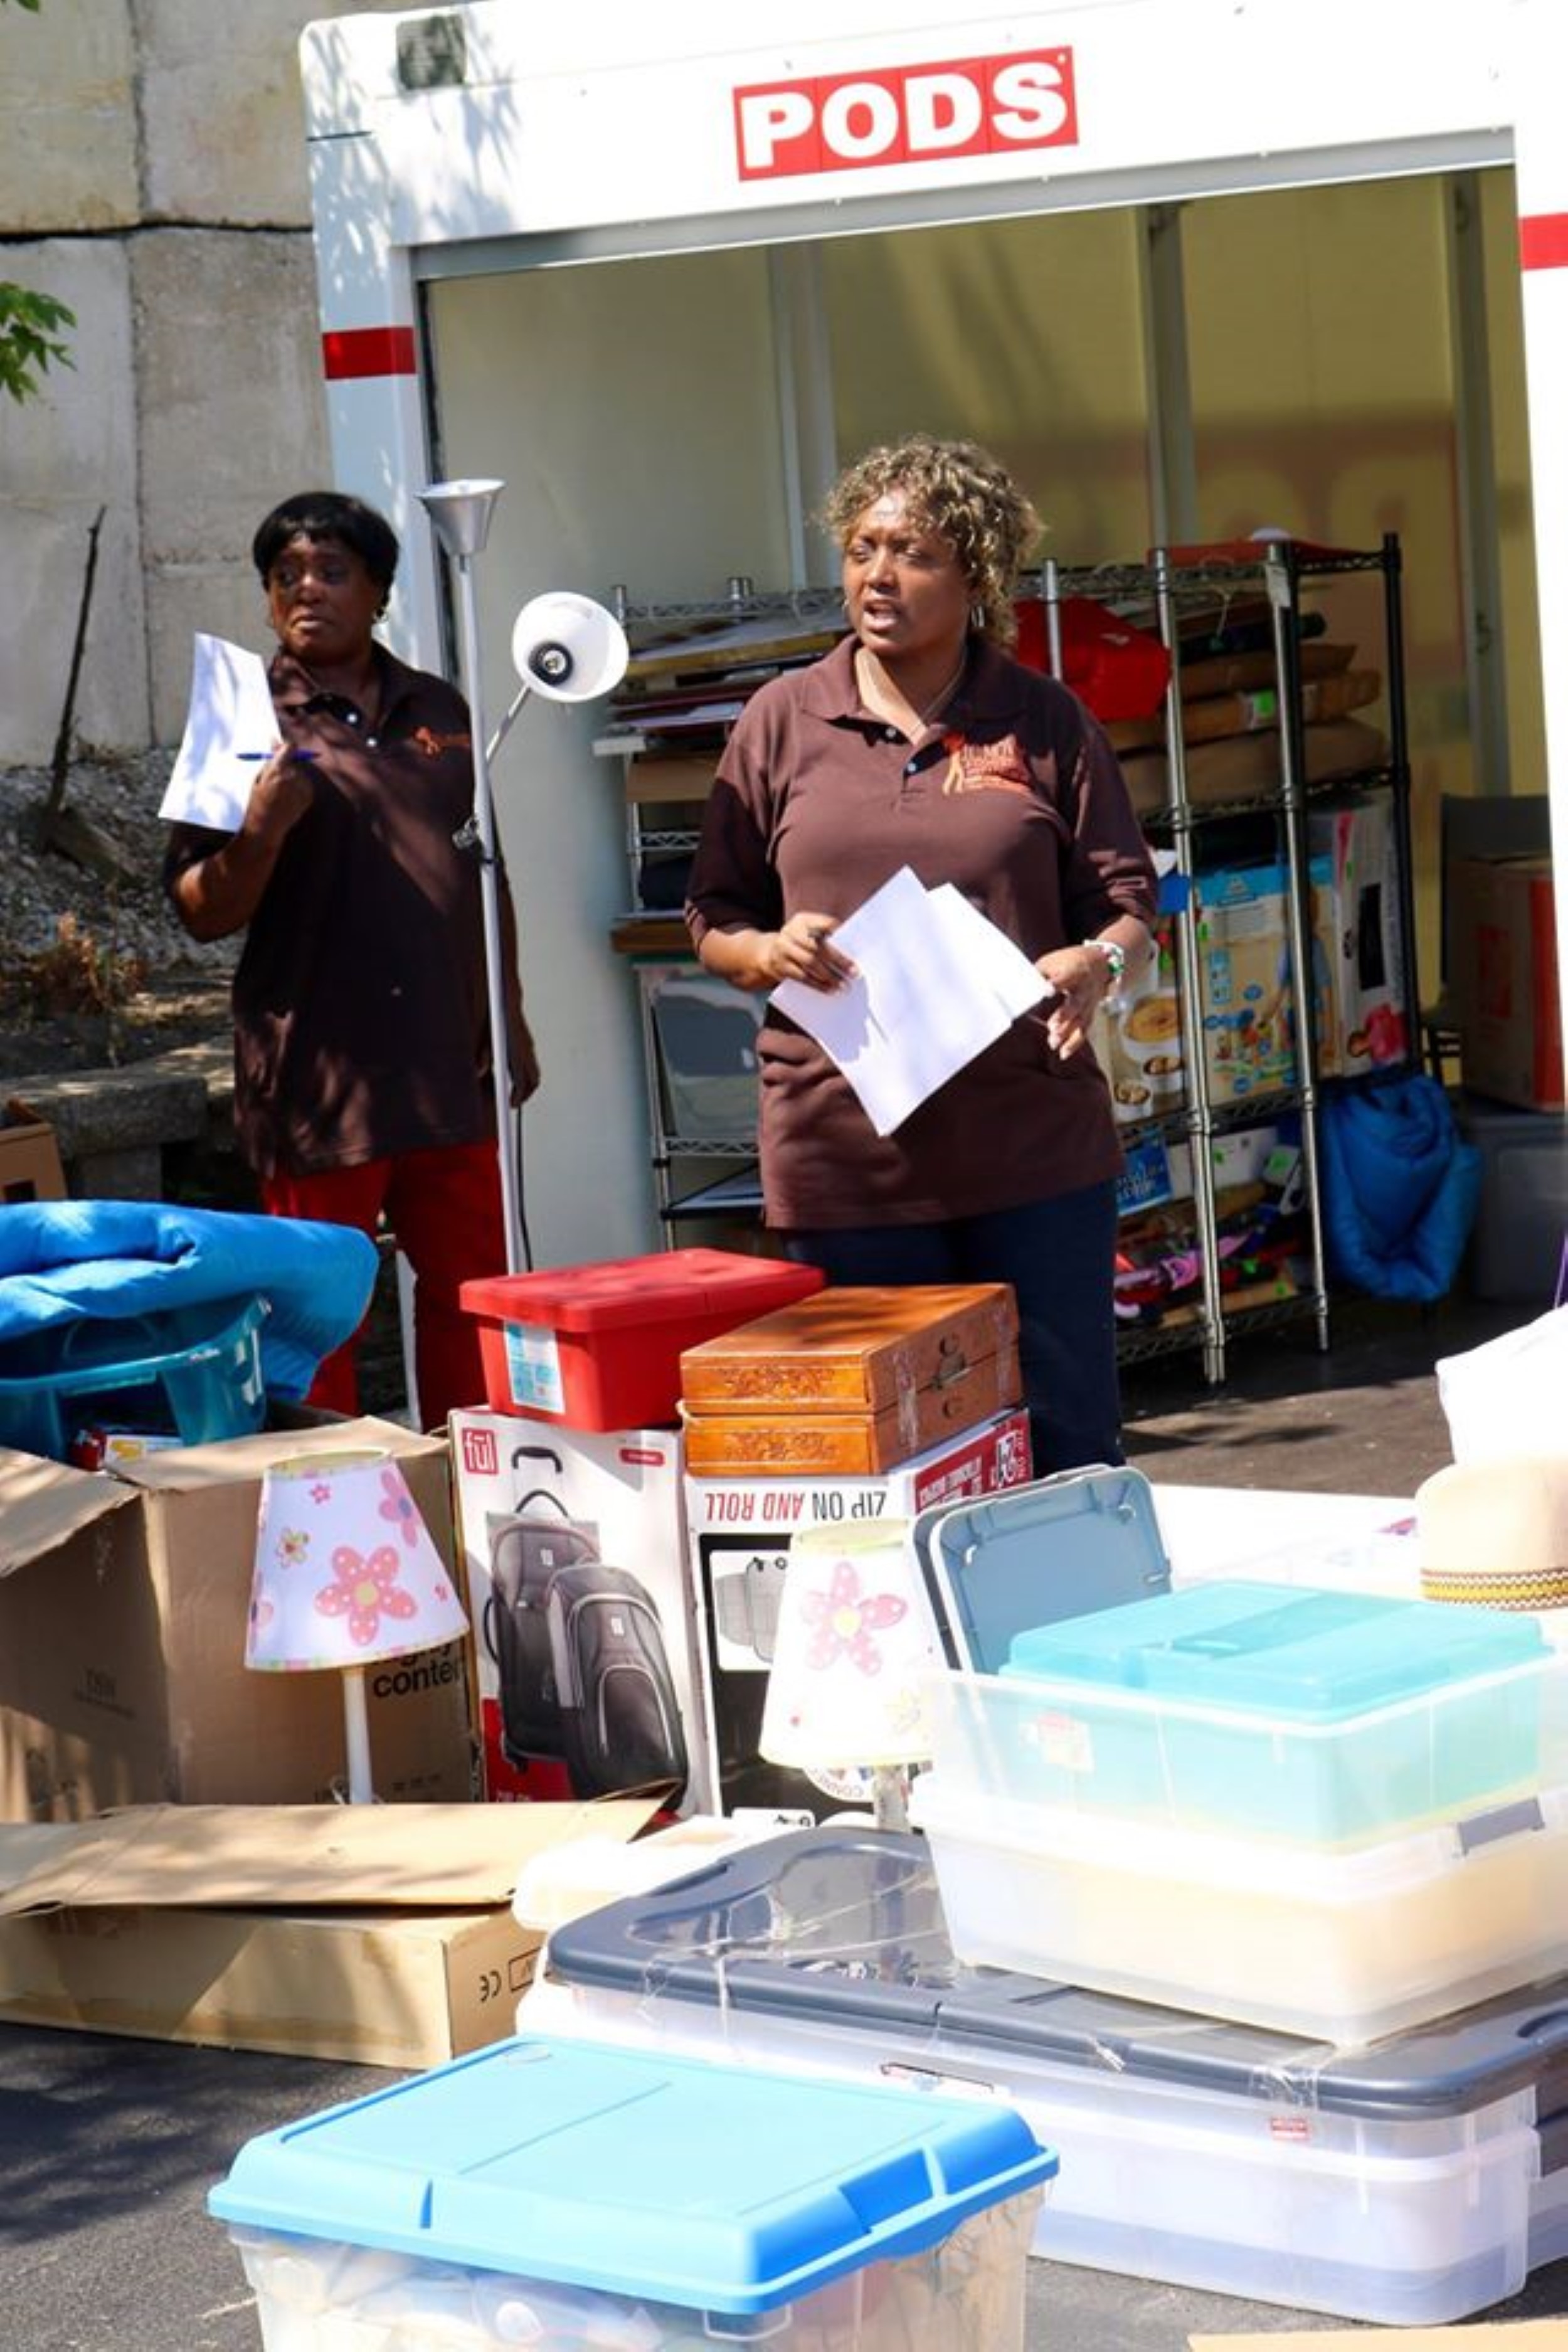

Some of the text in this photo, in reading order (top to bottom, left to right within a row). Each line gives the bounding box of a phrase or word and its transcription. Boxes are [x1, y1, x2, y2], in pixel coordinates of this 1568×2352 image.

[740, 61, 1068, 168] PODS
[704, 1490, 887, 1522] ZIP ON AND ROLL
